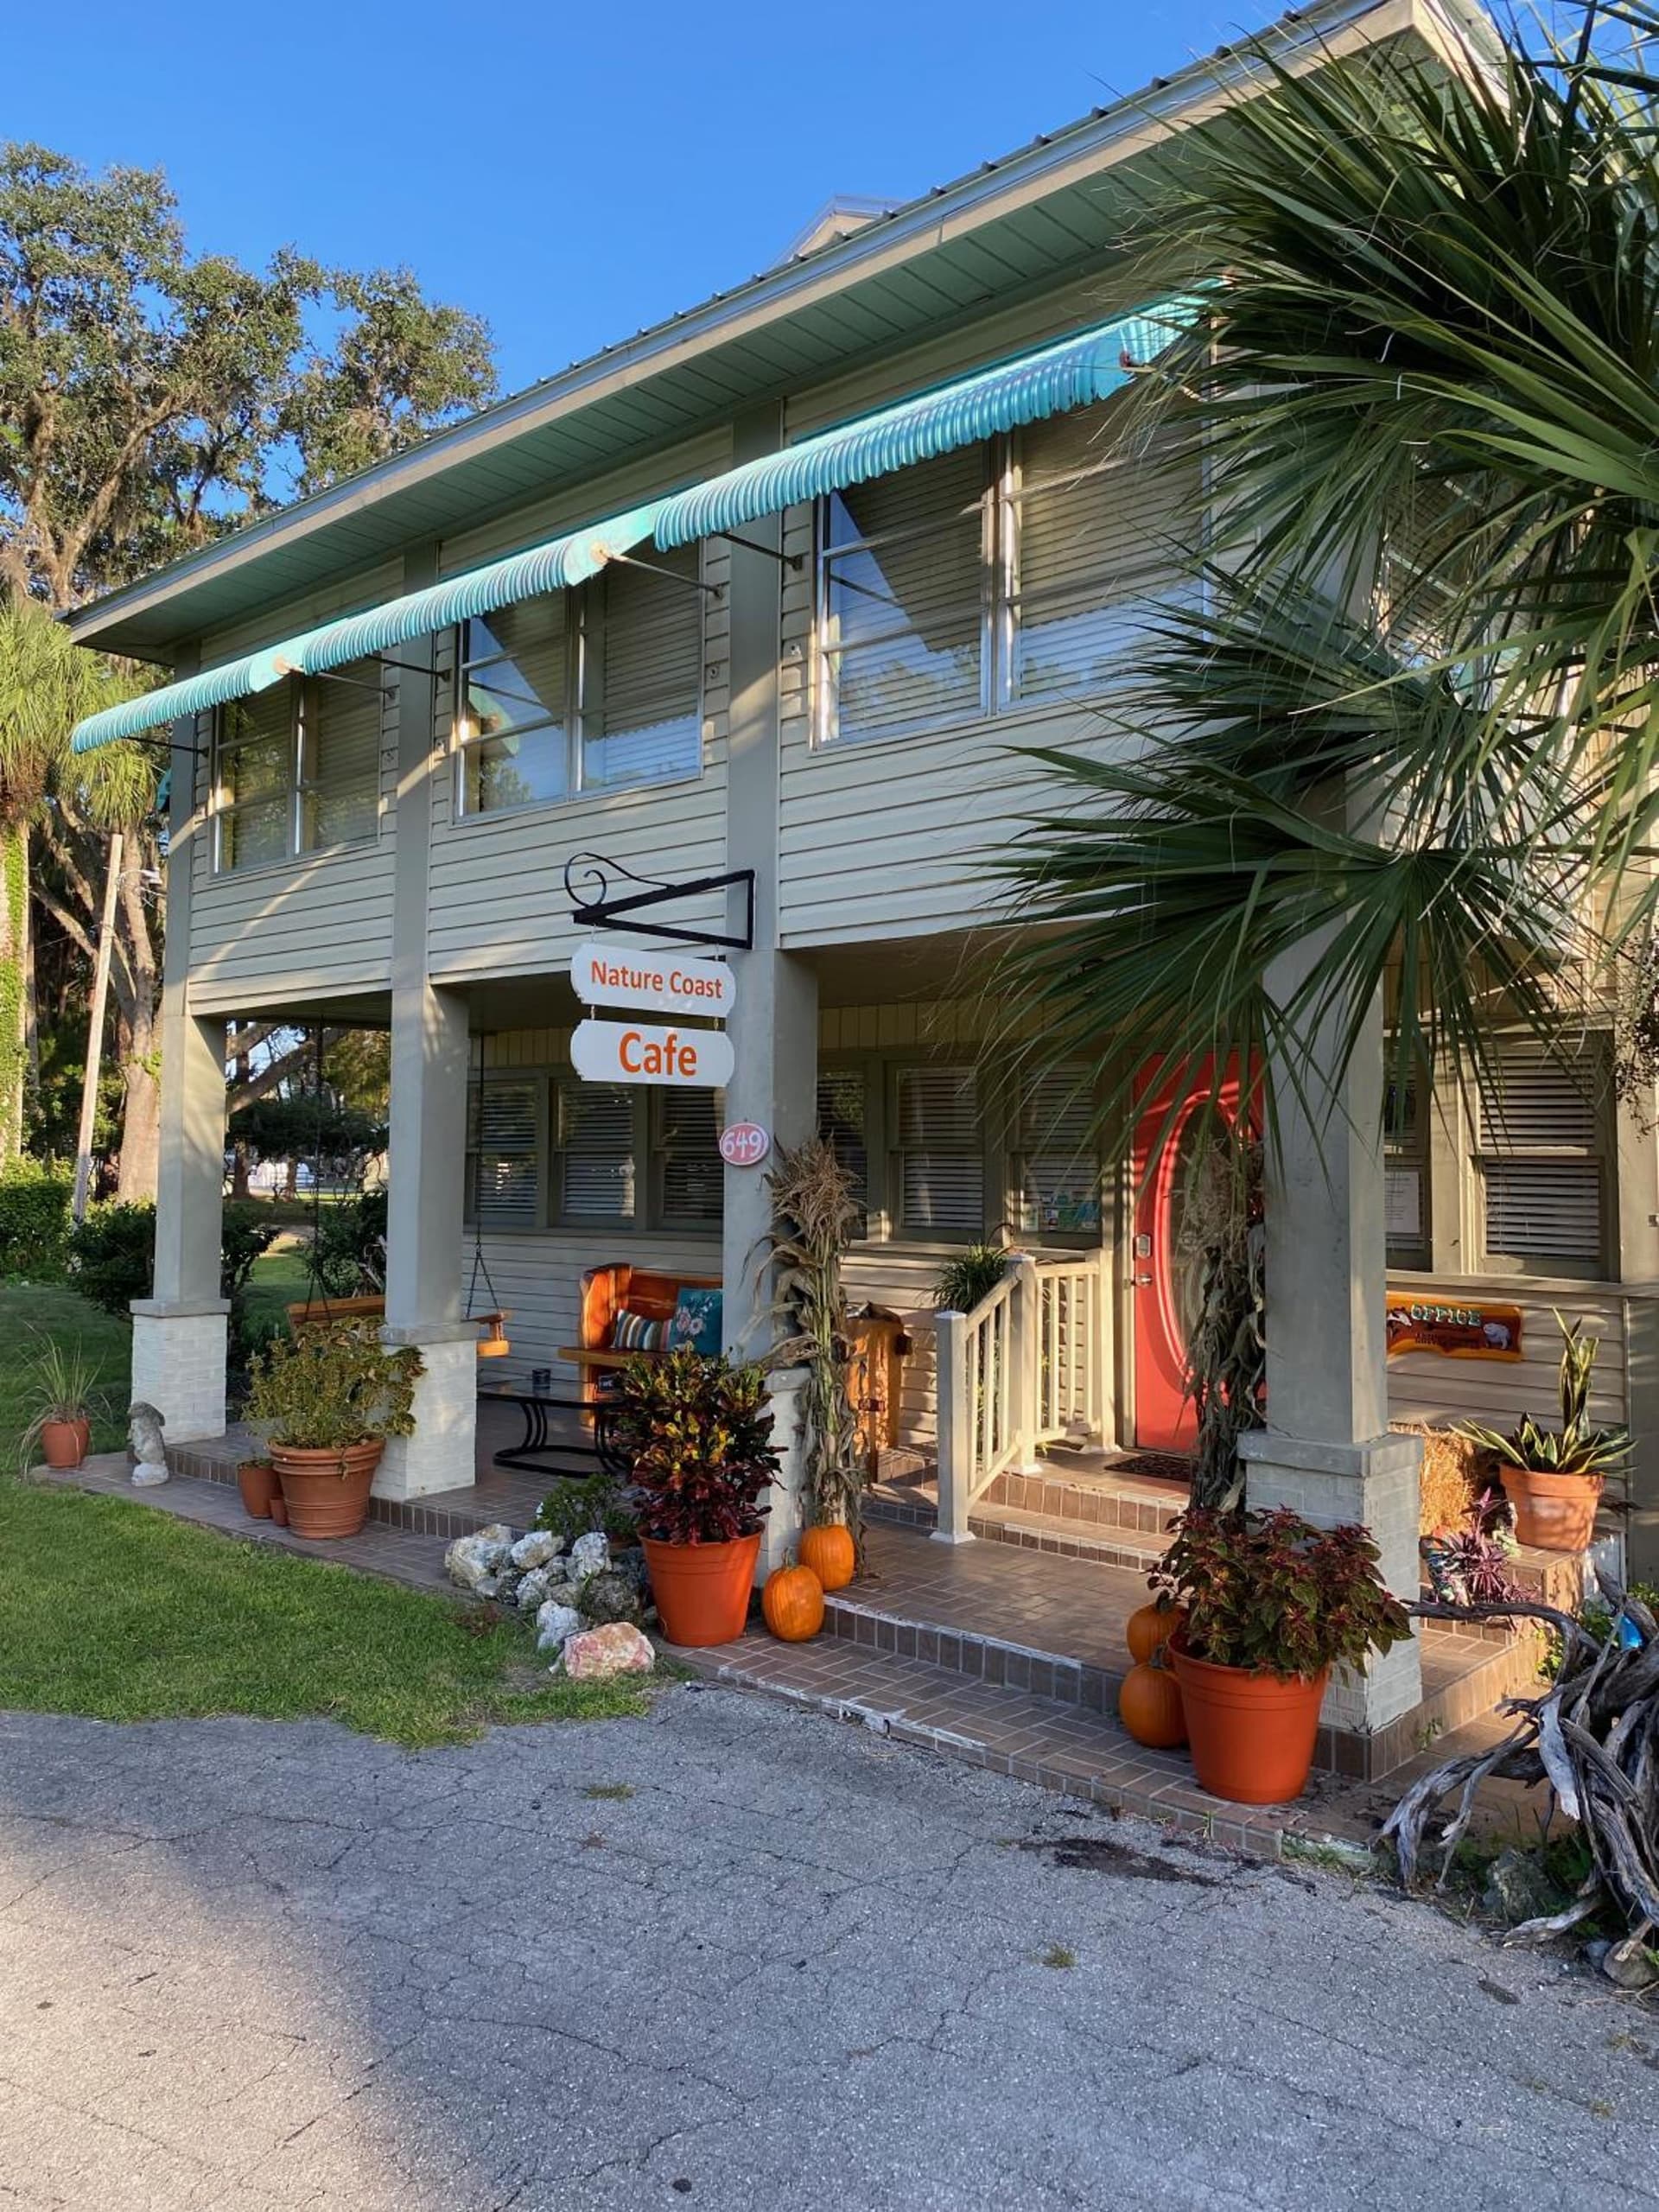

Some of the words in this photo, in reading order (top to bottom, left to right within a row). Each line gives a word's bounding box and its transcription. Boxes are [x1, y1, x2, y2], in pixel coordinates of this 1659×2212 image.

[591, 961, 663, 991] Nature
[670, 971, 721, 998] Coast
[619, 1032, 696, 1076] Cafe
[722, 1131, 763, 1158] 649
[1411, 1305, 1481, 1326] OFFICE
